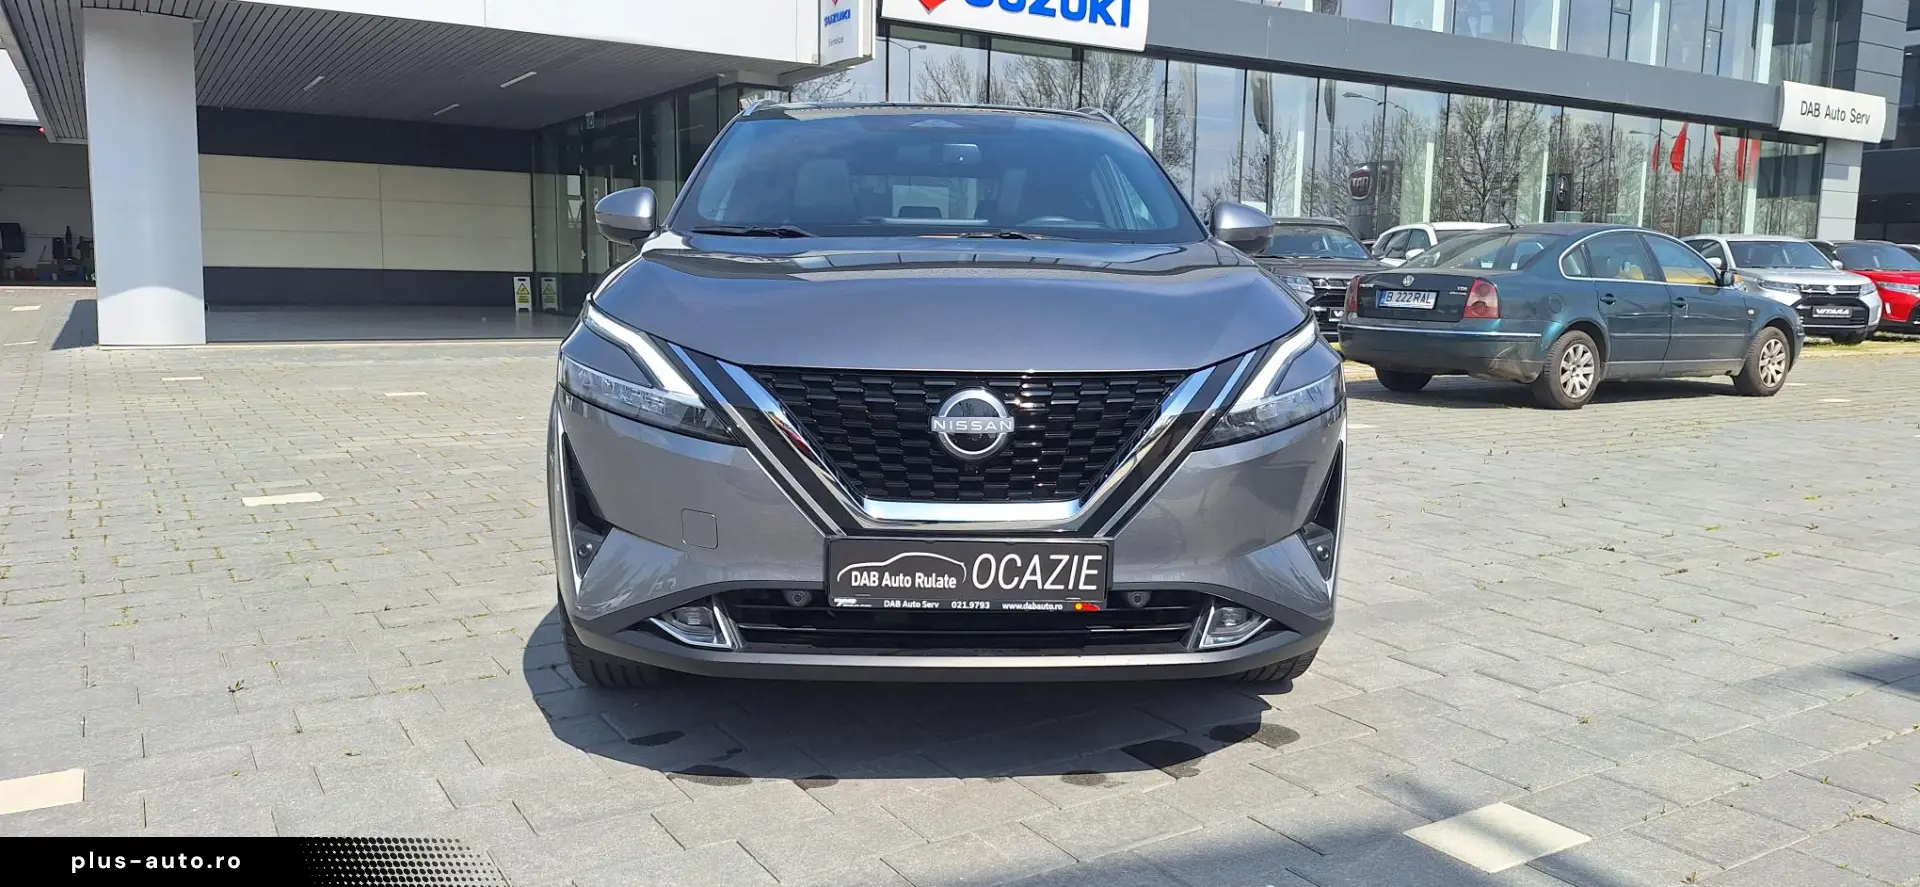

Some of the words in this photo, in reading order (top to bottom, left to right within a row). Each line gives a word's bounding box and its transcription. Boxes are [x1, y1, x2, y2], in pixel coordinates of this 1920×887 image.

[824, 9, 851, 27] SUZUKI
[965, 0, 1131, 28] ZUKI
[1800, 101, 1821, 118] DAB
[1824, 105, 1847, 122] Auto
[1849, 108, 1871, 125] Serv
[1386, 292, 1393, 302] B
[1413, 293, 1431, 304] RAL
[933, 420, 1012, 431] NISSAN
[851, 571, 879, 587] DAB
[881, 572, 912, 588] Auto
[915, 572, 957, 589] Rulate
[972, 553, 1103, 590] OCAZIE
[883, 600, 901, 608] DAB
[902, 600, 921, 609] Auto
[922, 601, 940, 609] Serv
[951, 601, 990, 609] 021.9793
[1002, 601, 1063, 610] www.dabauto.ro
